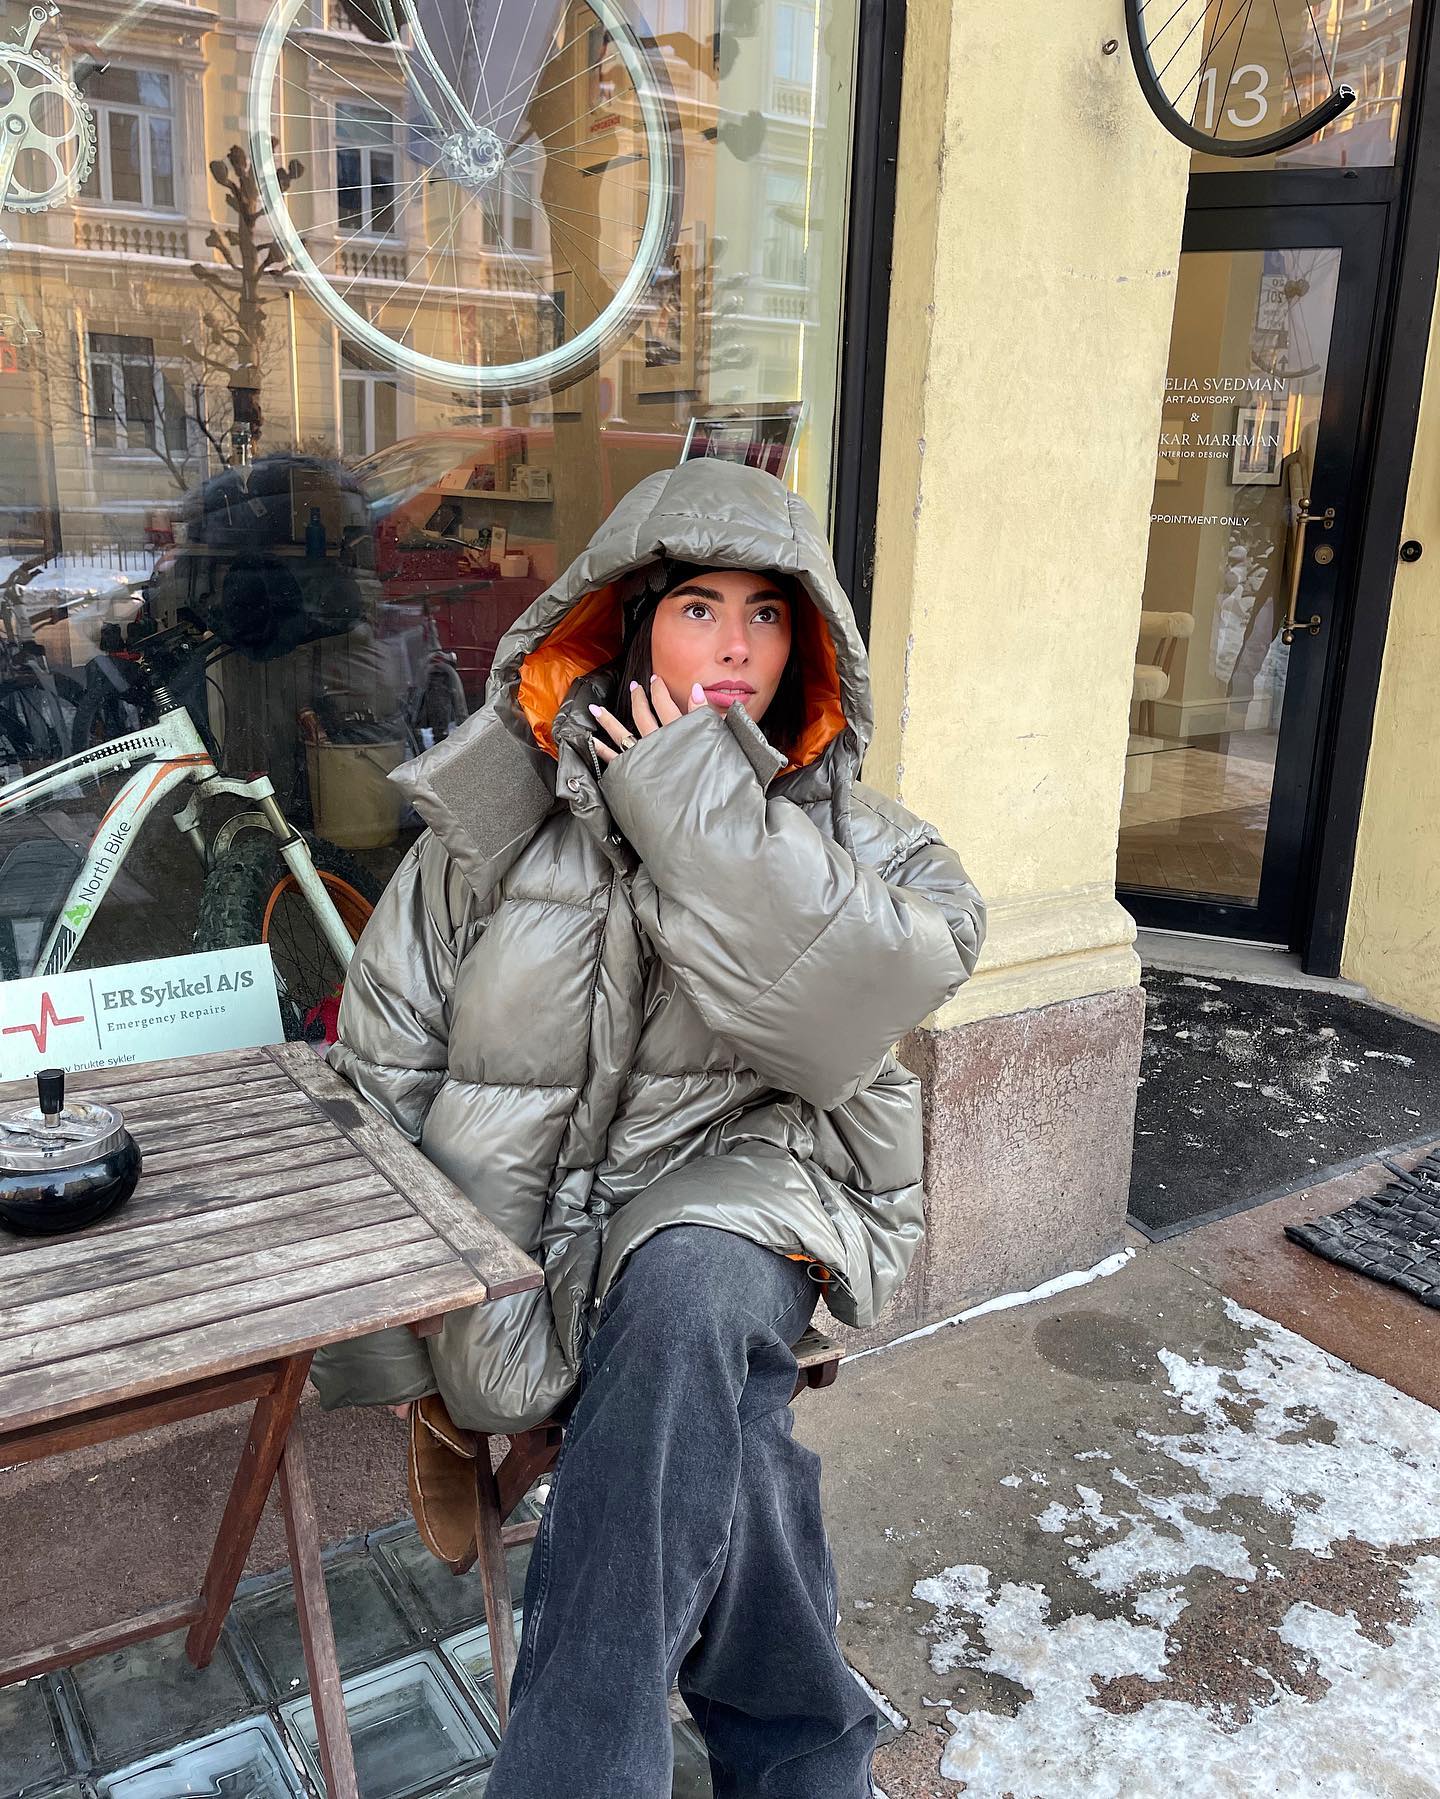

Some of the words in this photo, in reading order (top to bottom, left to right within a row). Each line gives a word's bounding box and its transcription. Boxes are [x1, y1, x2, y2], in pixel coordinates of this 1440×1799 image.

[1200, 64, 1269, 128] 13
[1165, 377, 1199, 391] ELIA
[1202, 377, 1286, 391] SVEDMAN
[1165, 395, 1185, 404] ART
[1186, 395, 1236, 404] ADVISORY
[1190, 412, 1200, 423] &
[1160, 433, 1191, 446] KAR
[1196, 433, 1280, 447] MARKMAN
[1158, 450, 1195, 458] INTERIOR
[1198, 451, 1229, 459] DESIGN
[1220, 516, 1250, 526] ONLY
[79, 856, 113, 902] North
[104, 821, 132, 855] Bike
[102, 990, 137, 1011] ER
[140, 974, 213, 1008] Sykkel
[216, 970, 255, 993] A/S
[107, 1015, 176, 1032] Emergency
[180, 1004, 226, 1021] Repairs
[73, 1059, 105, 1072] brukte
[107, 1054, 136, 1066] sykler
